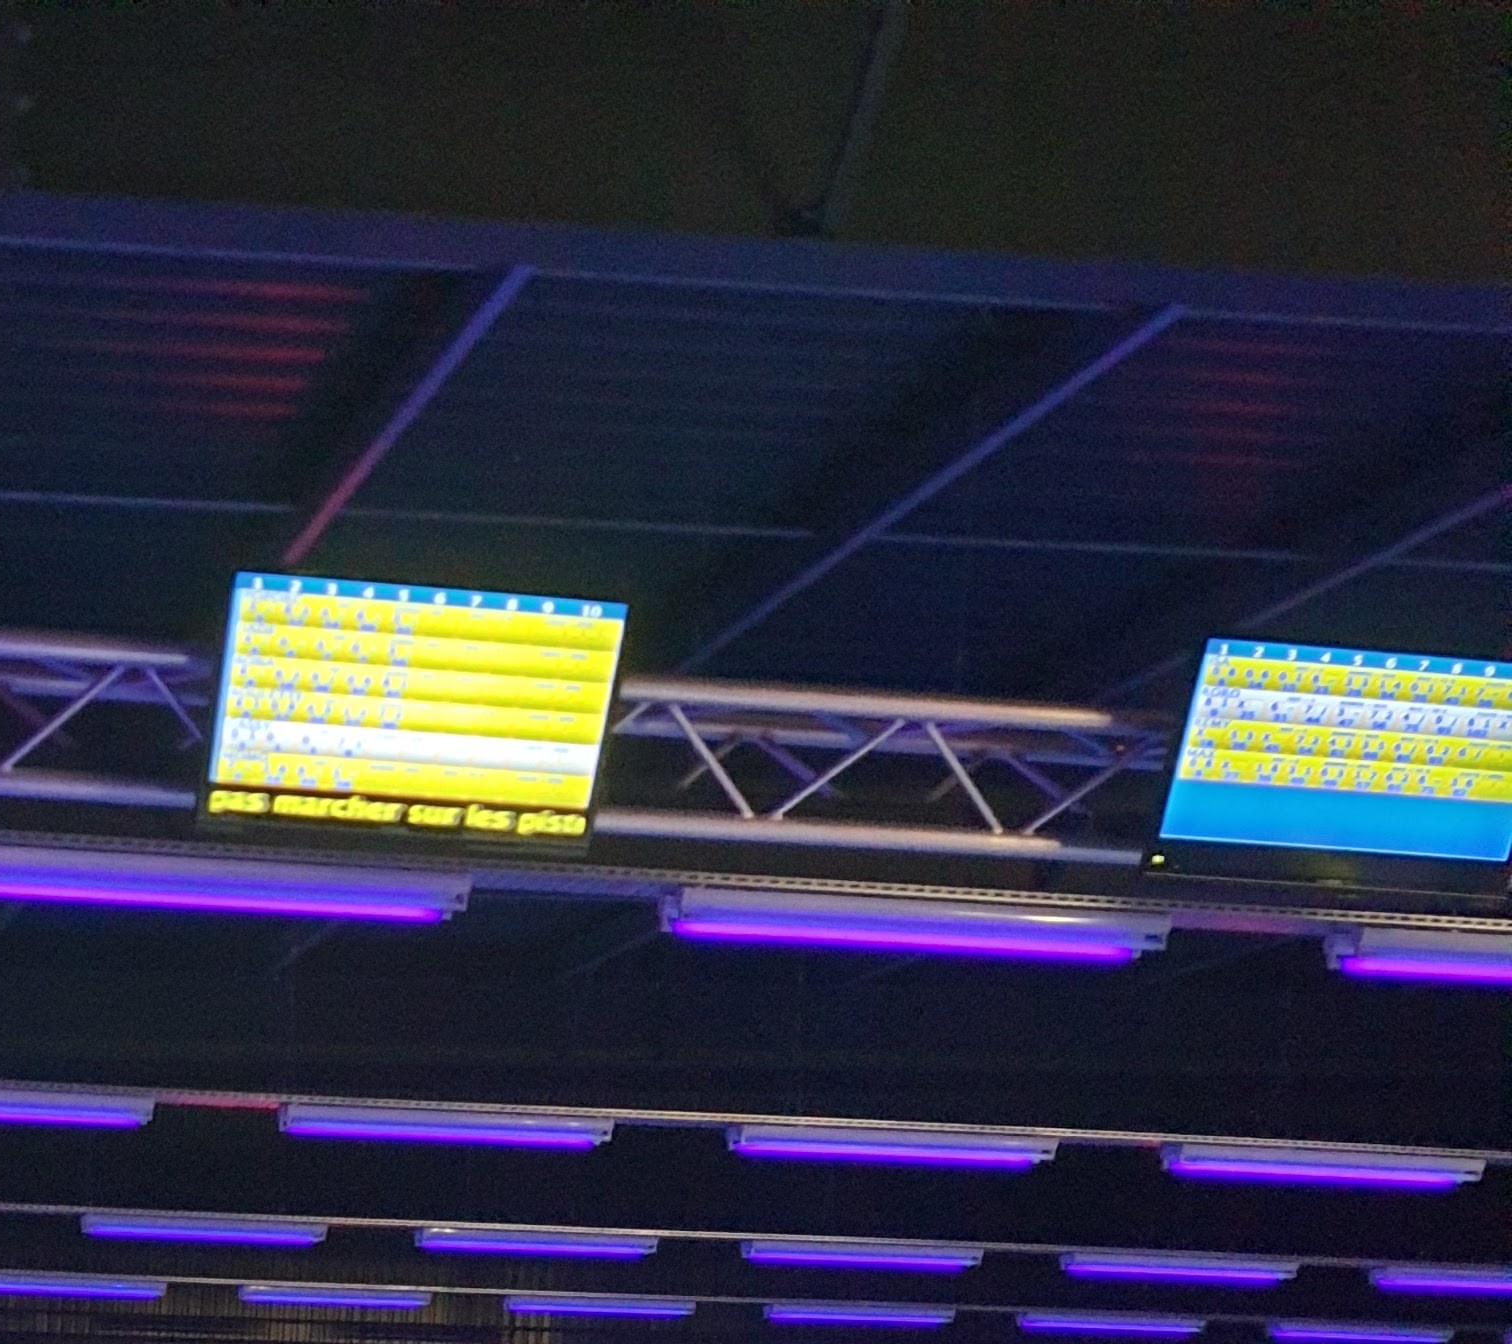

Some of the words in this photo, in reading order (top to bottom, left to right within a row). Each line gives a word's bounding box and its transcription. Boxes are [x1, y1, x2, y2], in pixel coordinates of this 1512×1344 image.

[290, 580, 302, 593] 2
[363, 587, 374, 599] 4
[433, 592, 446, 605] 6
[471, 595, 482, 608] 7
[542, 601, 554, 614] 9
[582, 604, 603, 618] 10
[1220, 643, 1228, 656] 1
[1253, 646, 1265, 658] 2
[1320, 652, 1331, 664] 4
[1353, 654, 1363, 666] 5
[1386, 657, 1397, 669] 6
[1419, 660, 1430, 671] 7
[209, 790, 270, 814] pas
[273, 795, 408, 823] marcher
[408, 804, 465, 827] sur
[465, 803, 516, 831] les
